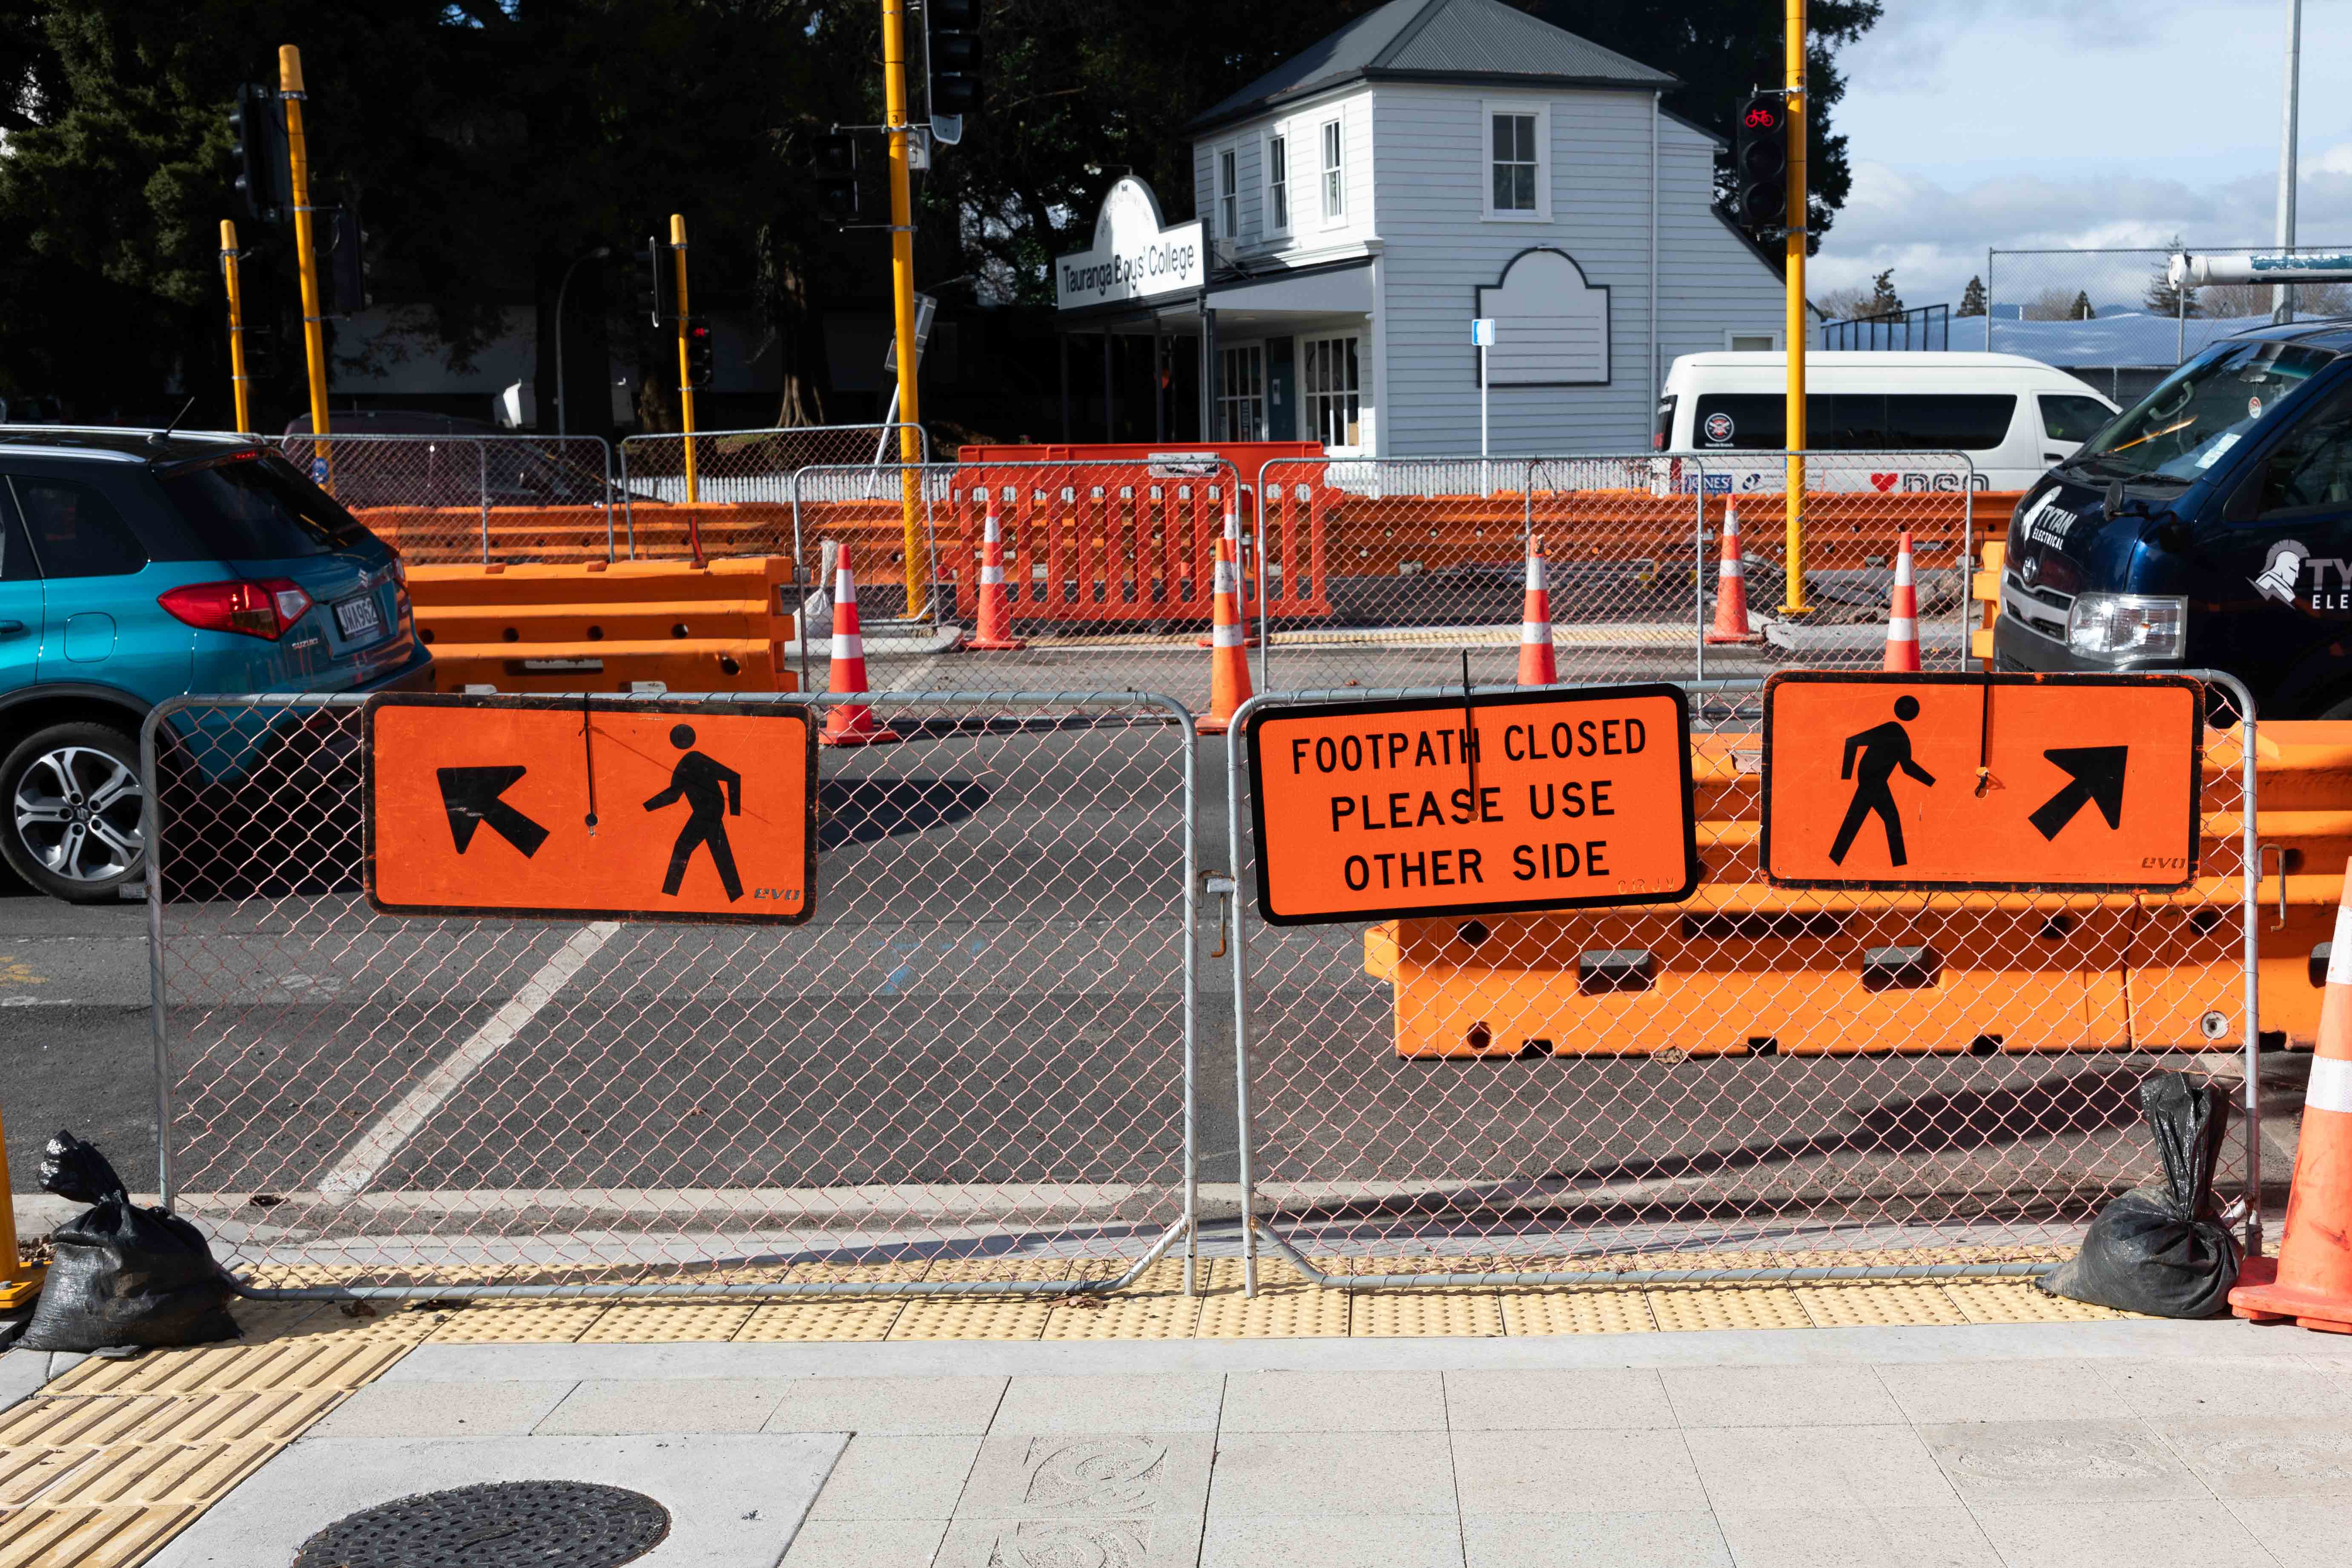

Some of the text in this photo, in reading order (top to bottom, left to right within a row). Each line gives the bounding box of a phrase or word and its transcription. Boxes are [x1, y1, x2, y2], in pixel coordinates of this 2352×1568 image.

[892, 115, 898, 123] 3
[1063, 242, 1194, 296] Tauranga Boys' College
[2032, 527, 2064, 550] ELECTRICAL
[2037, 505, 2077, 536] TYTAN
[2312, 594, 2349, 609] ELE
[1292, 718, 1646, 774] FOOTPATH CLOSED
[1332, 780, 1615, 831] PLEASE USE
[1345, 840, 1609, 891] OTHER SIDE
